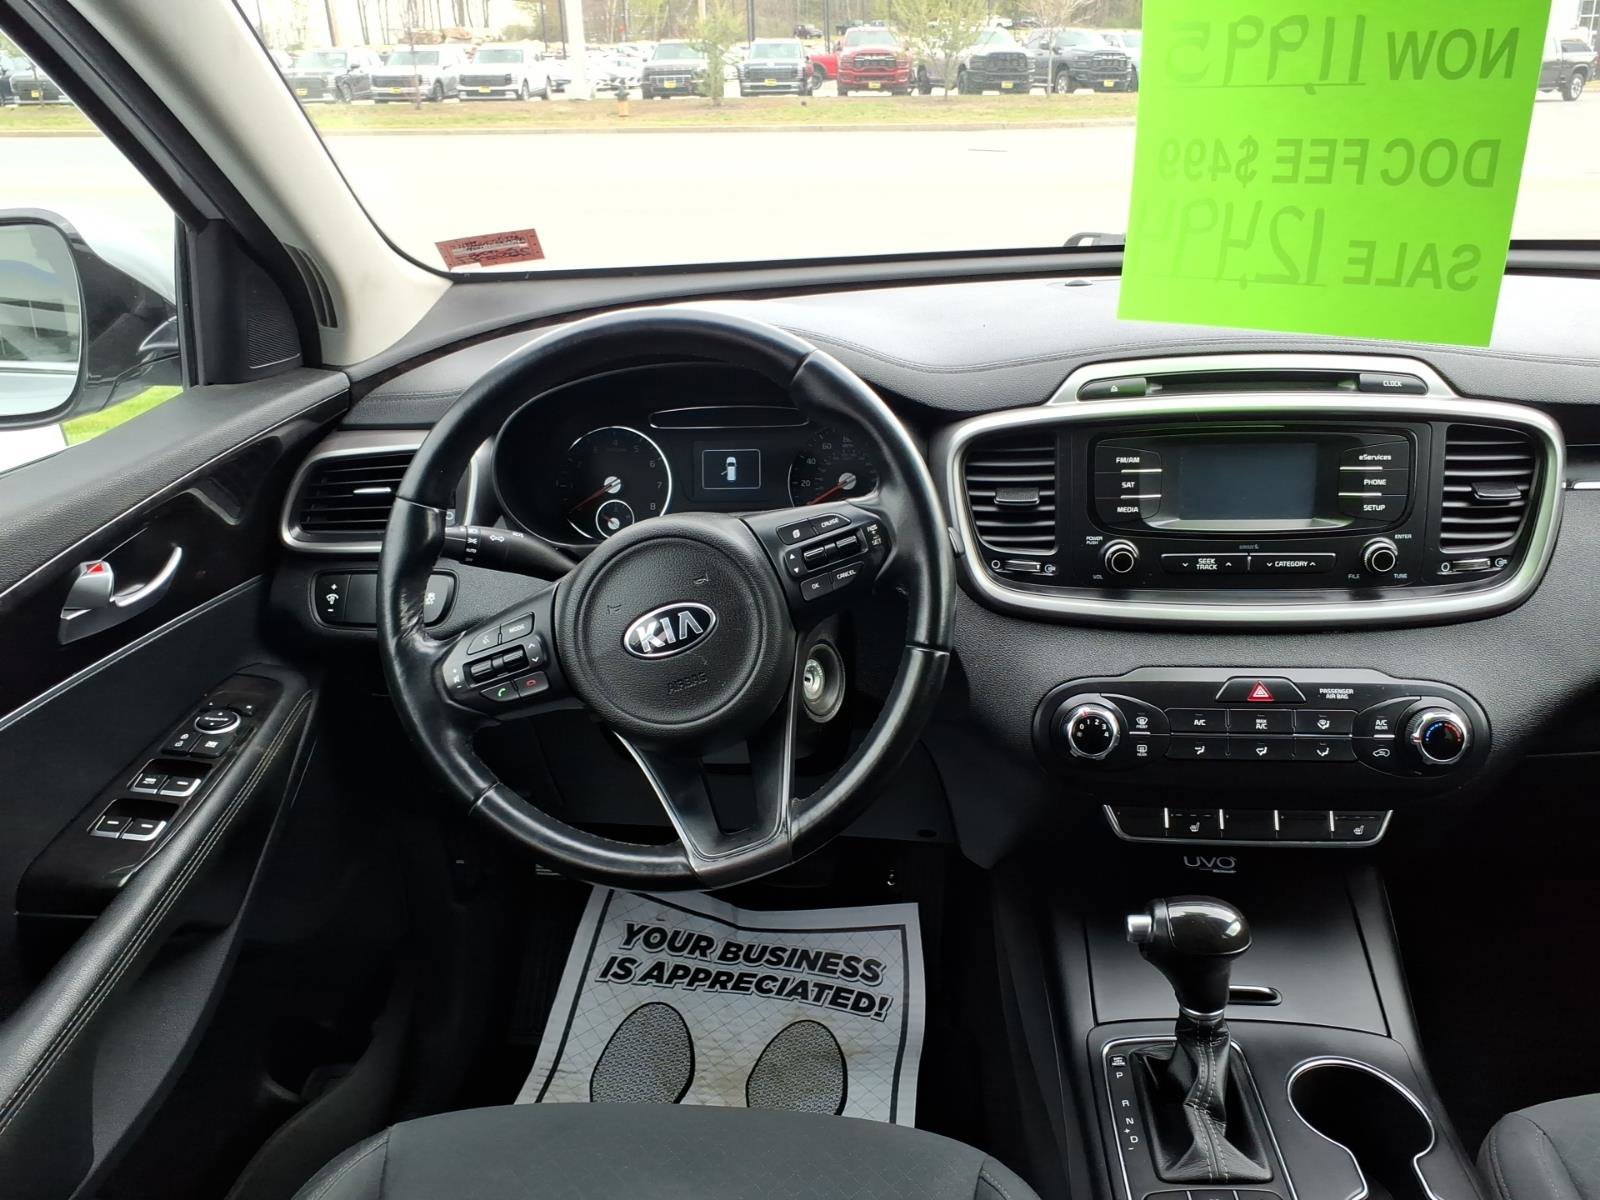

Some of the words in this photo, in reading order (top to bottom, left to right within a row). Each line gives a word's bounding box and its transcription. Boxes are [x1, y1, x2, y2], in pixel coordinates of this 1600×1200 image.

[1116, 456, 1140, 464] FM/AM
[1358, 453, 1392, 461] eServices
[1121, 481, 1135, 489] SAT
[1363, 478, 1387, 486] PHONE
[1117, 505, 1139, 514] MEDIA
[1363, 504, 1386, 512] SETUP
[1274, 560, 1308, 568] CATEGORY
[636, 610, 704, 653] KIA
[1184, 856, 1236, 868] UVO
[619, 923, 715, 961] YOUR
[717, 939, 887, 986] BUSINESS
[596, 956, 641, 983] IS
[636, 962, 894, 1022] APPRECIATED!
[1126, 1117, 1135, 1125] N
